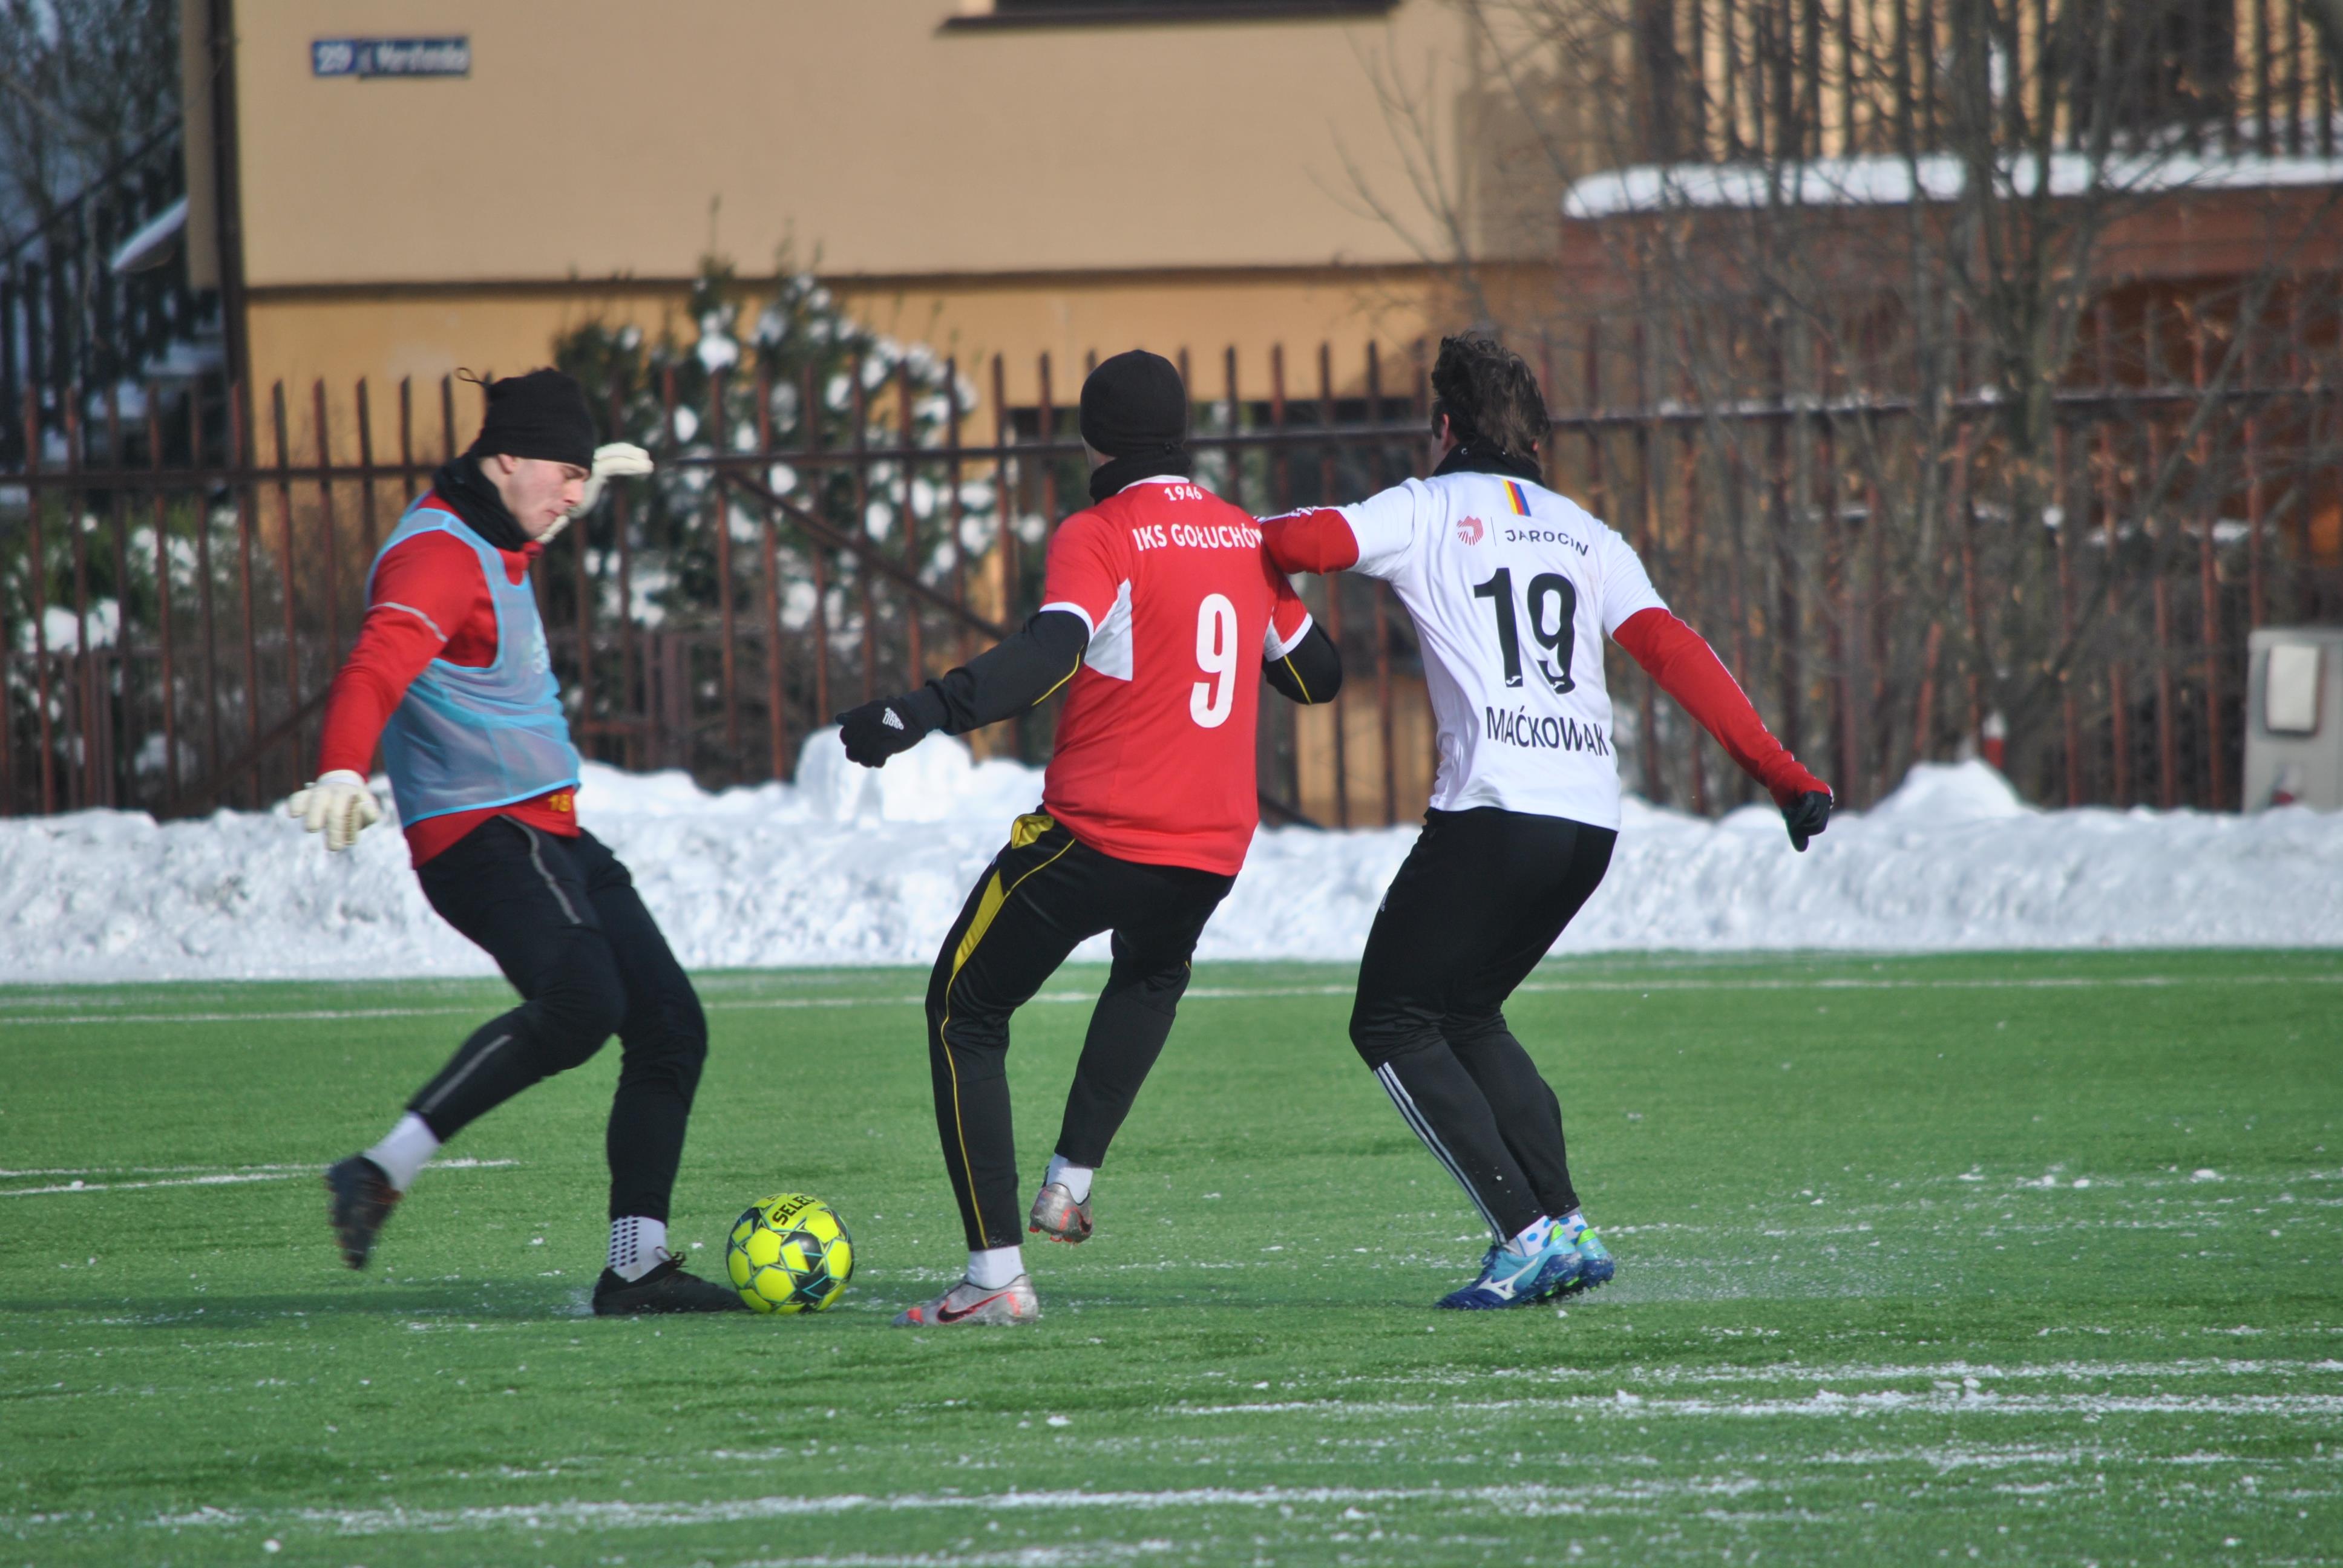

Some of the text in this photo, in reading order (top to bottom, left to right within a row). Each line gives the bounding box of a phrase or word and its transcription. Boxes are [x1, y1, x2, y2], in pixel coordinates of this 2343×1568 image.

[1164, 486, 1203, 501] 1946
[1504, 529, 1589, 557] JAROCIN
[1189, 593, 1238, 728] 9
[1473, 567, 1576, 694] 19
